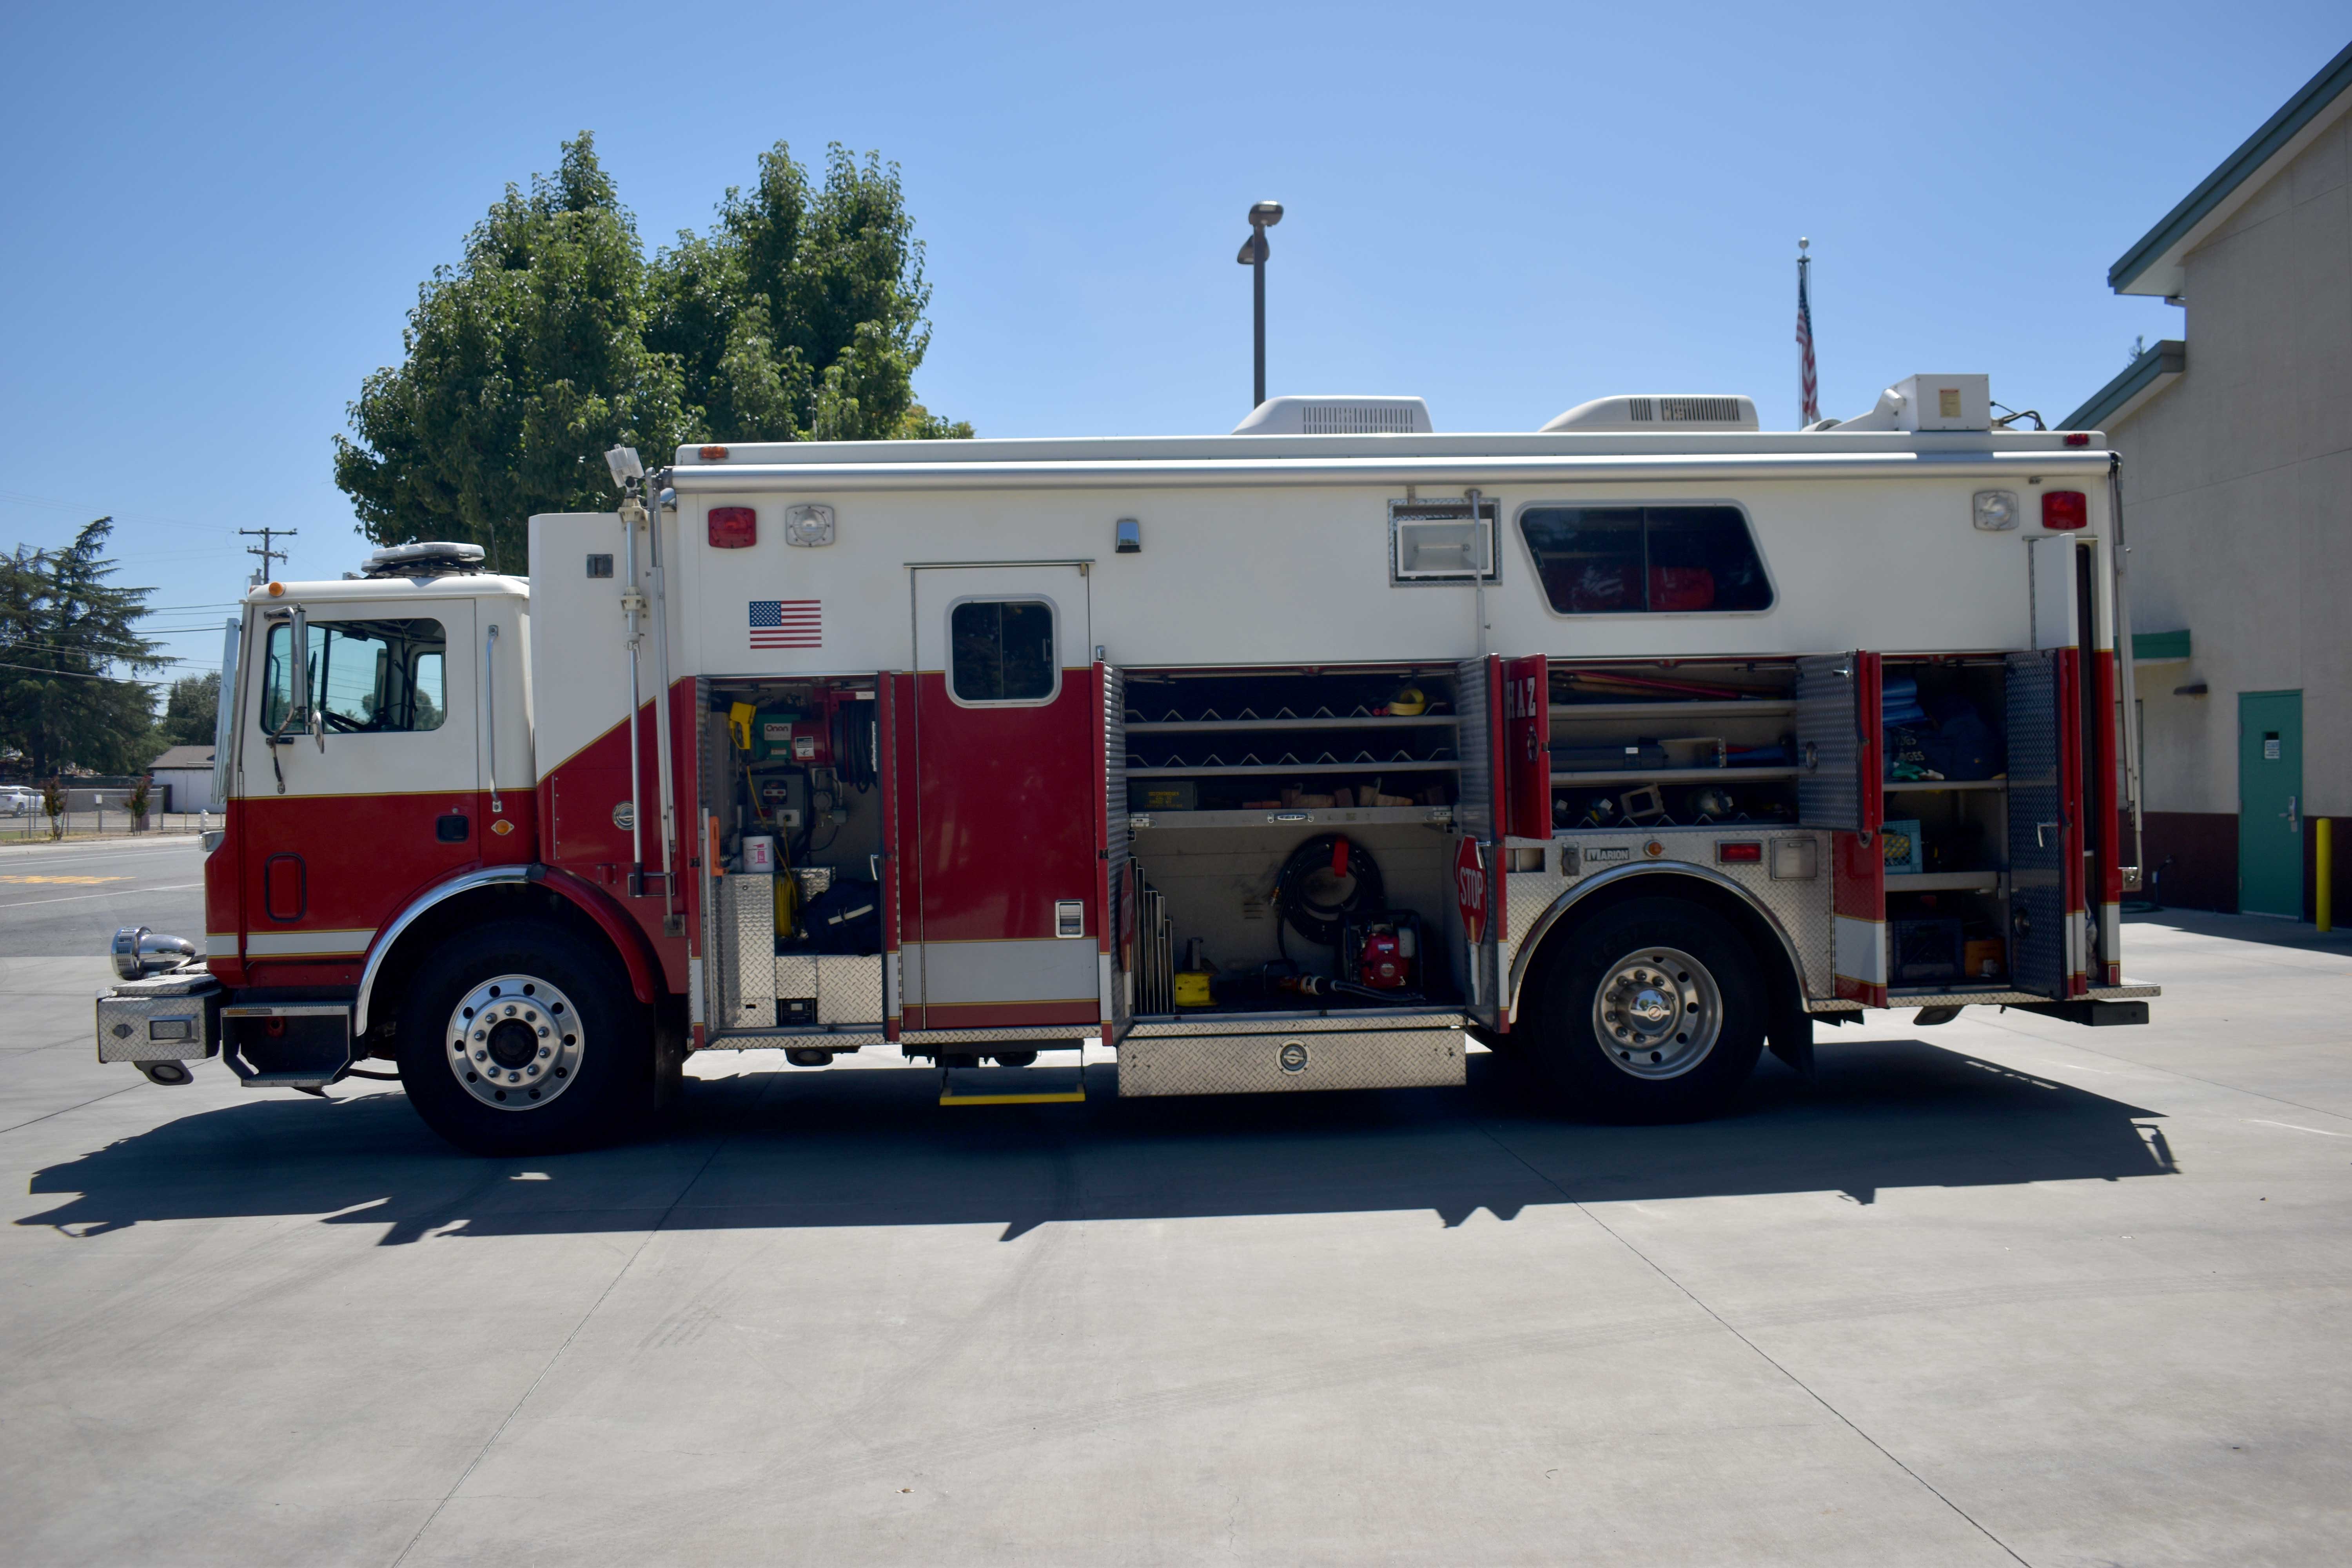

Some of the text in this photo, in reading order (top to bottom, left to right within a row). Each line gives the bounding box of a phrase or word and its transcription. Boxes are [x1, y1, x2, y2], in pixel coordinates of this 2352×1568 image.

[1506, 677, 1536, 719] HAZ
[1586, 849, 1629, 860] MARION
[1460, 866, 1483, 909] STOP
[1122, 892, 1132, 941] STOP
